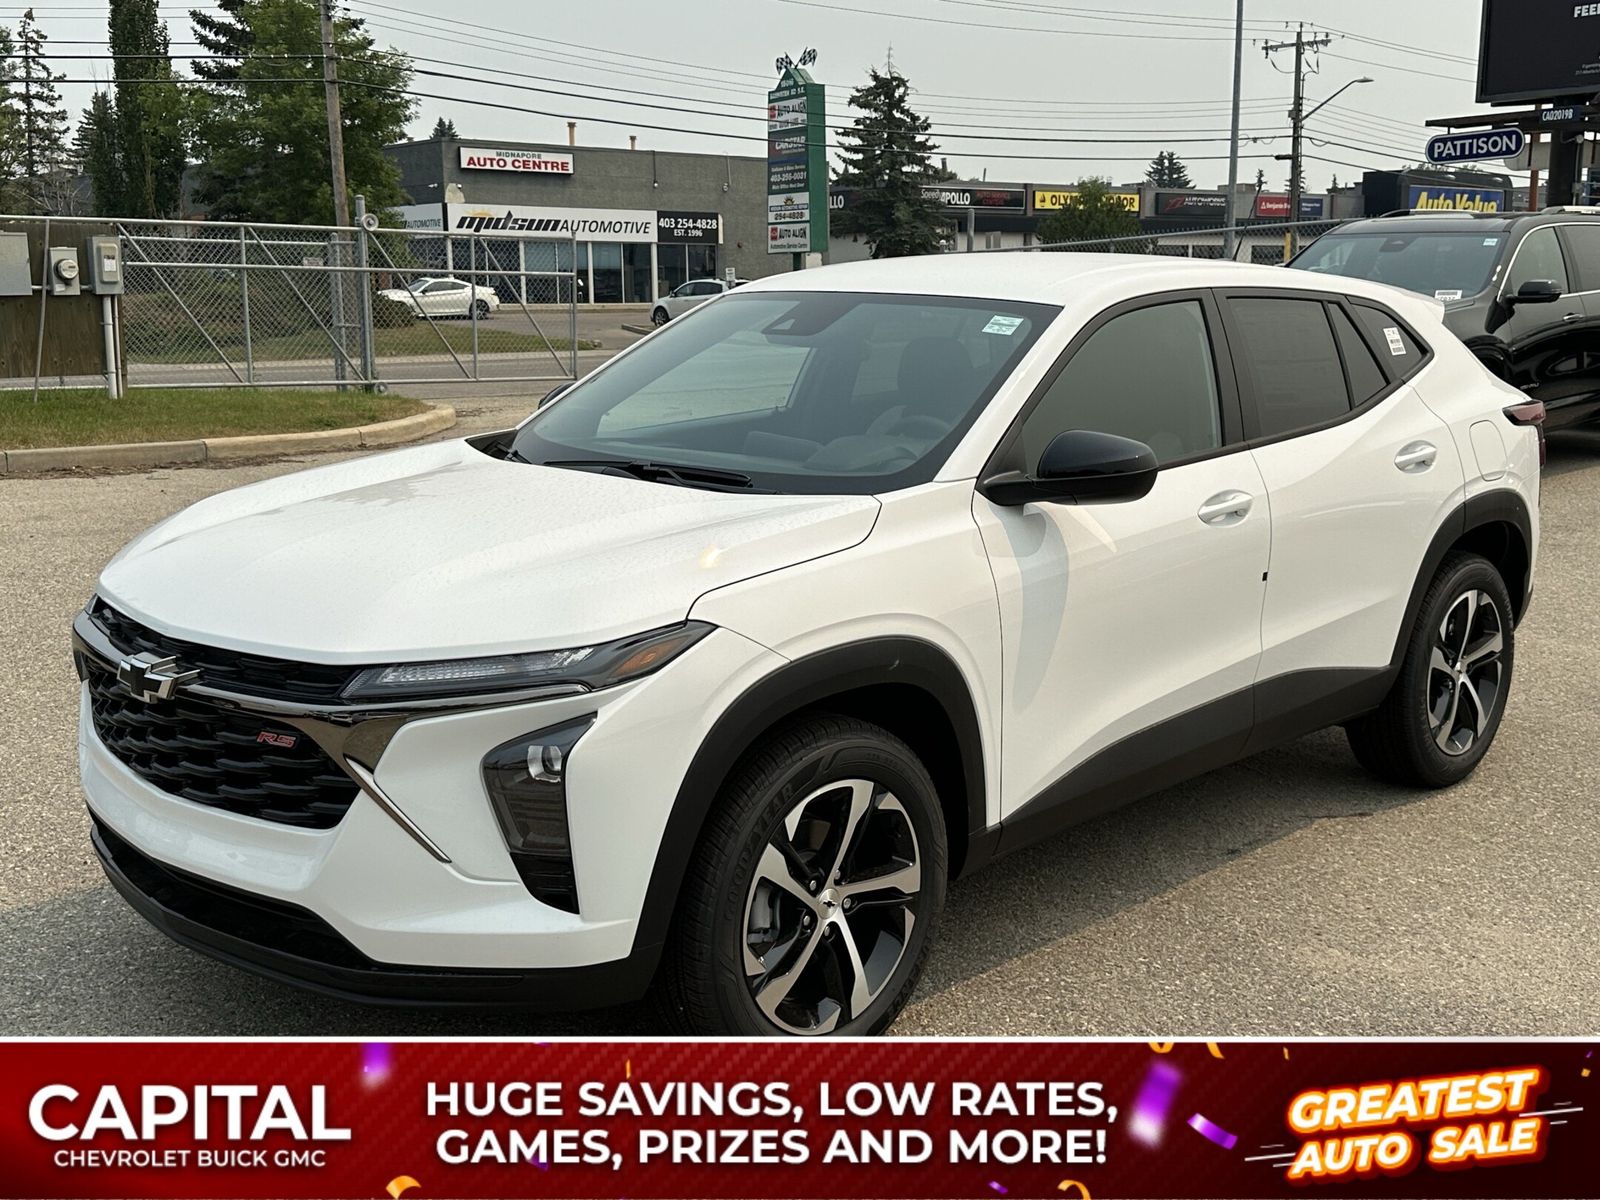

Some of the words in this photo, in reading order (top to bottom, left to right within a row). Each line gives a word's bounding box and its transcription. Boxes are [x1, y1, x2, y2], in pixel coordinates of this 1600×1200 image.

[1433, 134, 1517, 159] PATTISON
[496, 151, 542, 159] MIDNAPORE
[466, 157, 507, 169] AUTO
[511, 159, 570, 172] CENTRE
[1416, 191, 1454, 210] Auto
[1455, 193, 1498, 212] Value
[407, 218, 441, 229] AUTOMOTIVE
[559, 219, 652, 234] AUTOMOTIVE
[658, 218, 675, 229] 403
[677, 218, 718, 230] 254-4828
[688, 229, 703, 237] 1996
[257, 731, 297, 748] RS
